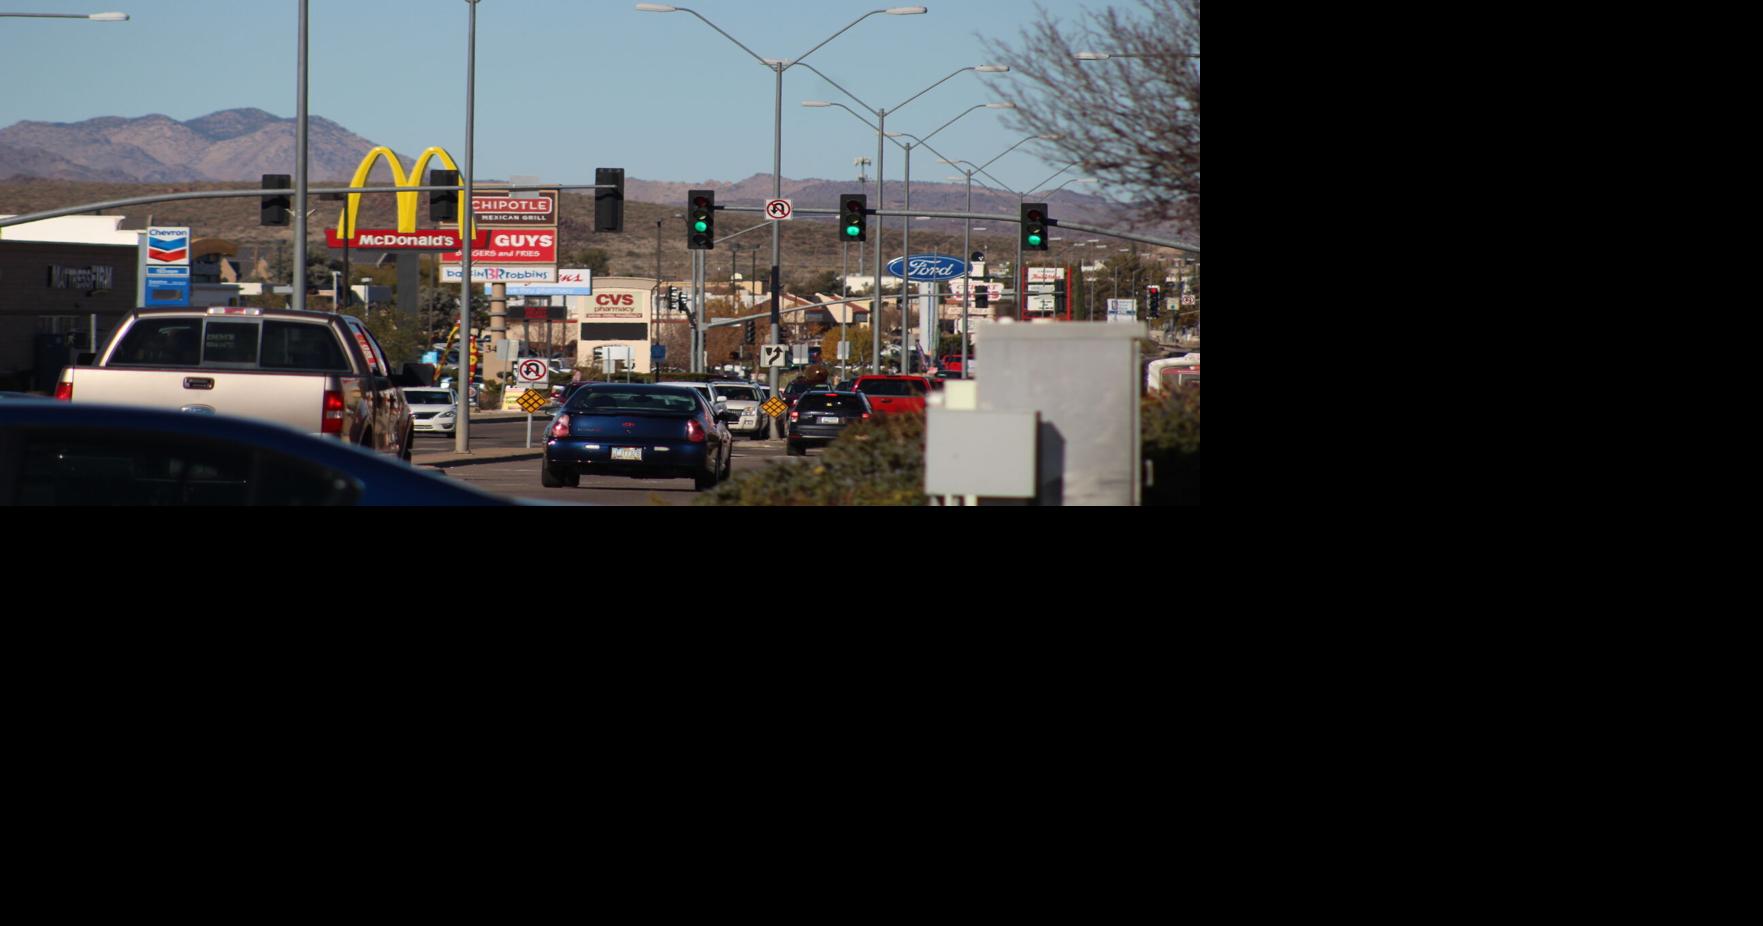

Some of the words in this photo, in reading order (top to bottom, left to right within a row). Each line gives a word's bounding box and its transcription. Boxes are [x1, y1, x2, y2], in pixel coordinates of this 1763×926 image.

[471, 200, 547, 210] CHIPOTLE
[360, 234, 454, 246] McDonald's
[495, 234, 553, 247] GUYS
[498, 249, 513, 257] and
[908, 260, 954, 276] Ford
[505, 270, 548, 280] robbins
[595, 294, 634, 305] CVS
[594, 305, 635, 313] pharmacy
